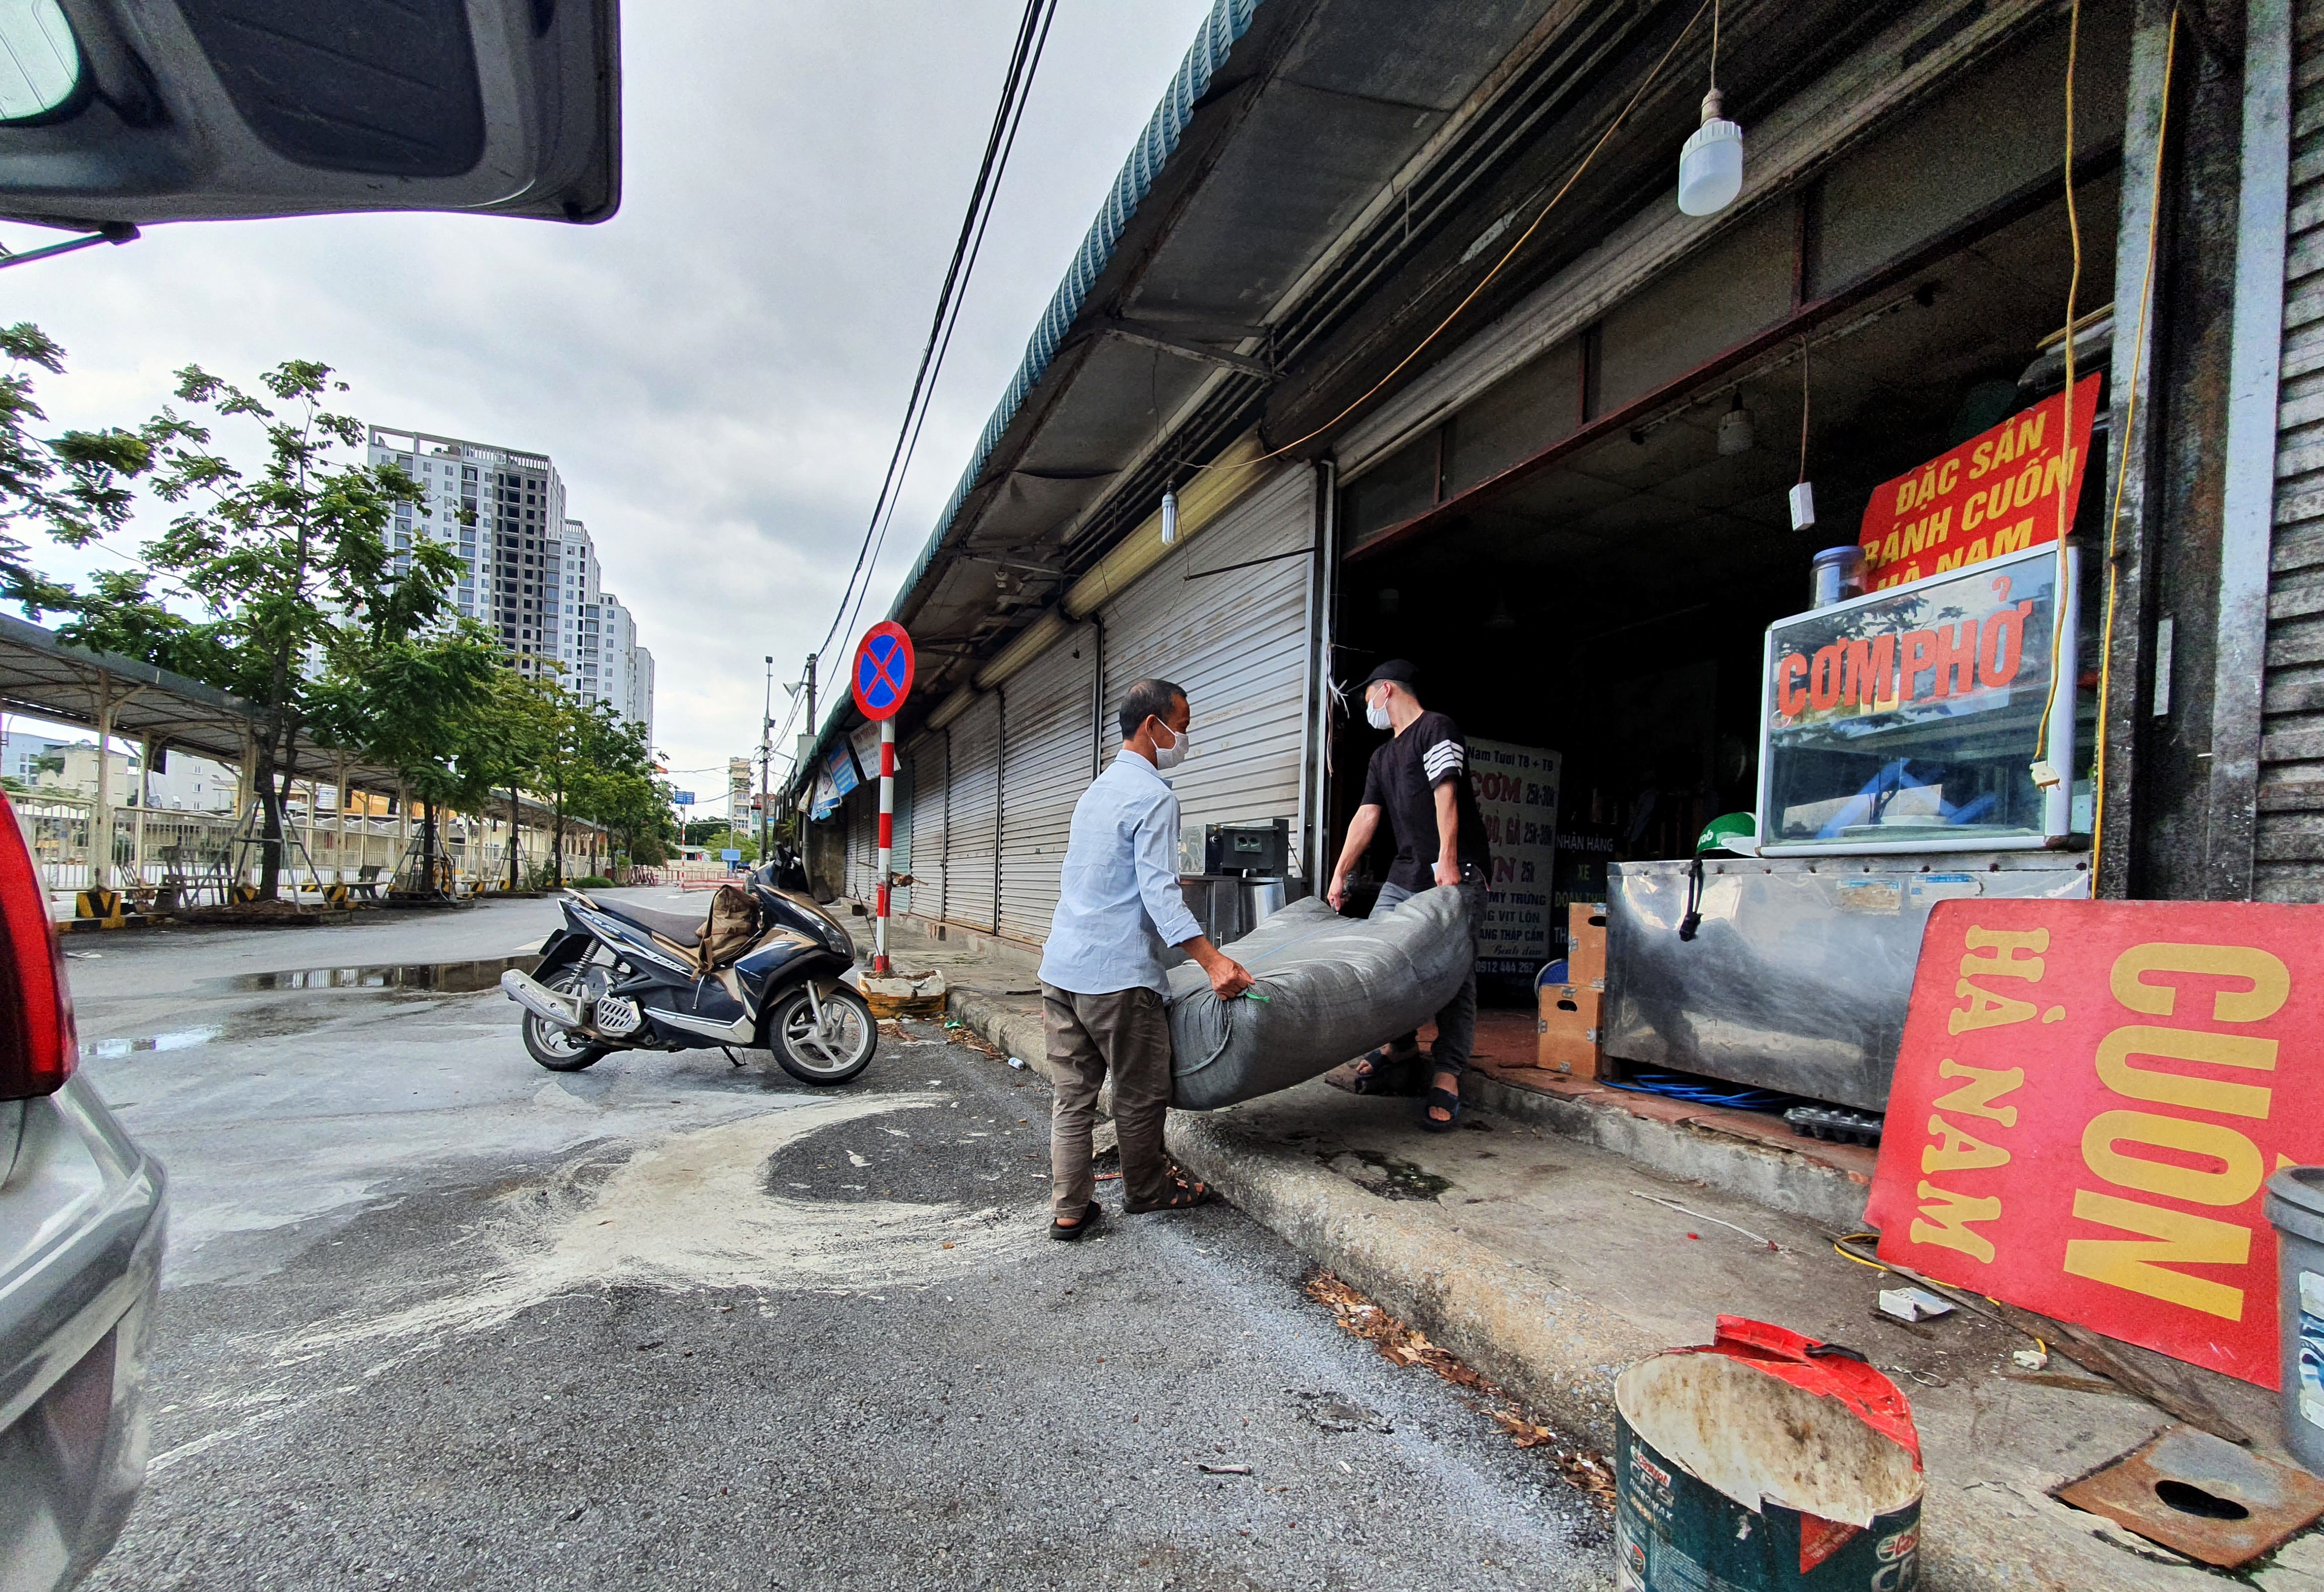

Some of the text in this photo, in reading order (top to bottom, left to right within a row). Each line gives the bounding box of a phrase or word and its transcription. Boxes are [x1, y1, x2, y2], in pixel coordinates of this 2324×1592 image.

[1896, 411, 2046, 516] ĐẶC SẢN
[1863, 447, 2078, 571] BÁNH CUỐN
[1936, 517, 2034, 574] NAM
[1778, 576, 2034, 717] CƠM PHỞ
[1518, 754, 1529, 768] T8
[1542, 758, 1553, 772] T9
[1469, 770, 1522, 803] CƠM
[1556, 832, 1614, 853] NHẬN HÀNG
[1578, 863, 1591, 881] XE
[1499, 910, 1515, 924] VỊT
[1909, 924, 2066, 1264] HÀ NAM
[1638, 1454, 1669, 1486] Castrol
